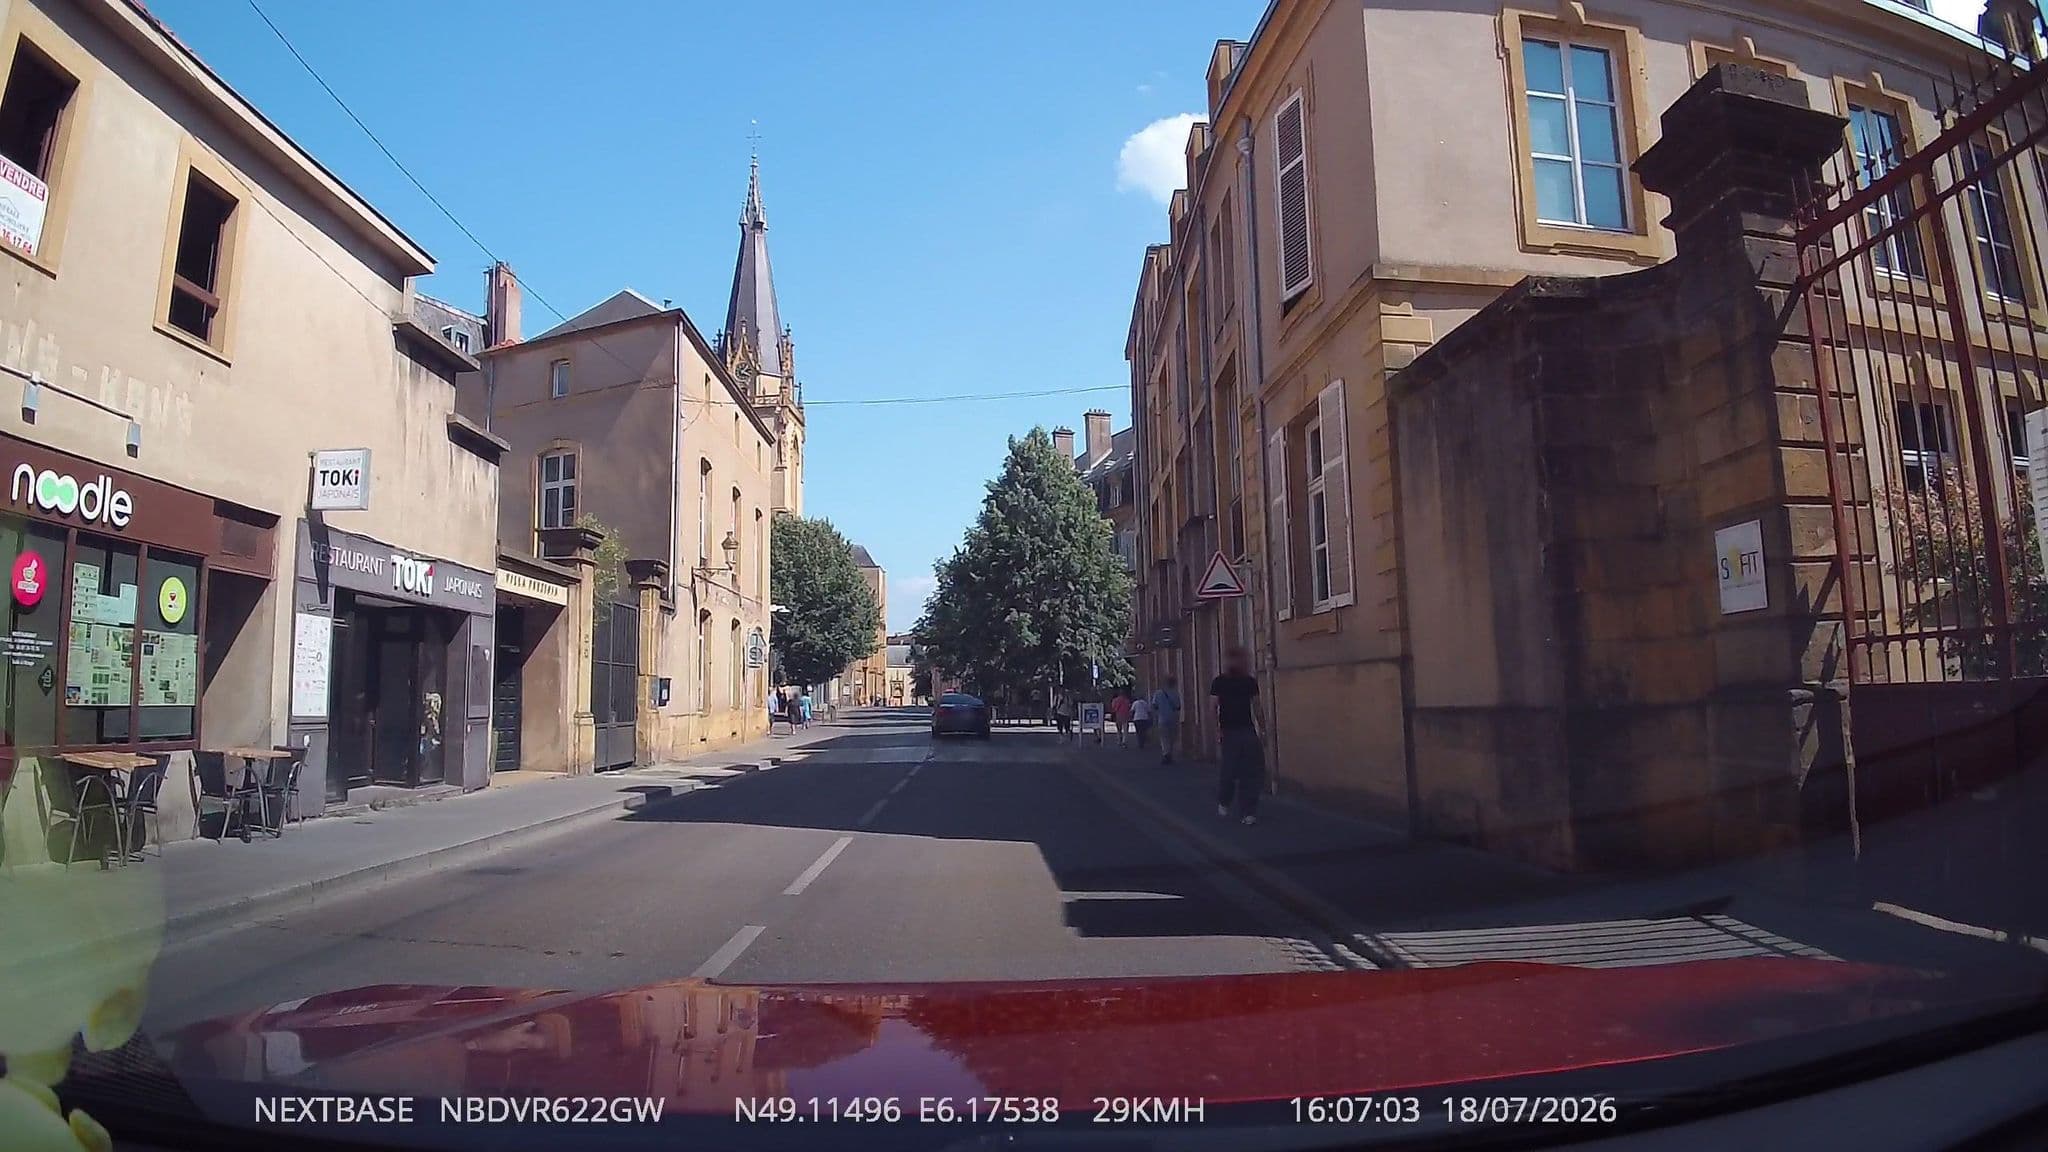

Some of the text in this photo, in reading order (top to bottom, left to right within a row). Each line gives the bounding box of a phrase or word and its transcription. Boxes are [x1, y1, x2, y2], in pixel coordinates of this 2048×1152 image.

[0, 161, 45, 199] VENDRE
[11, 463, 133, 527] noodle
[311, 541, 386, 576] RESTAURANT
[444, 576, 483, 598] JAPONAIS
